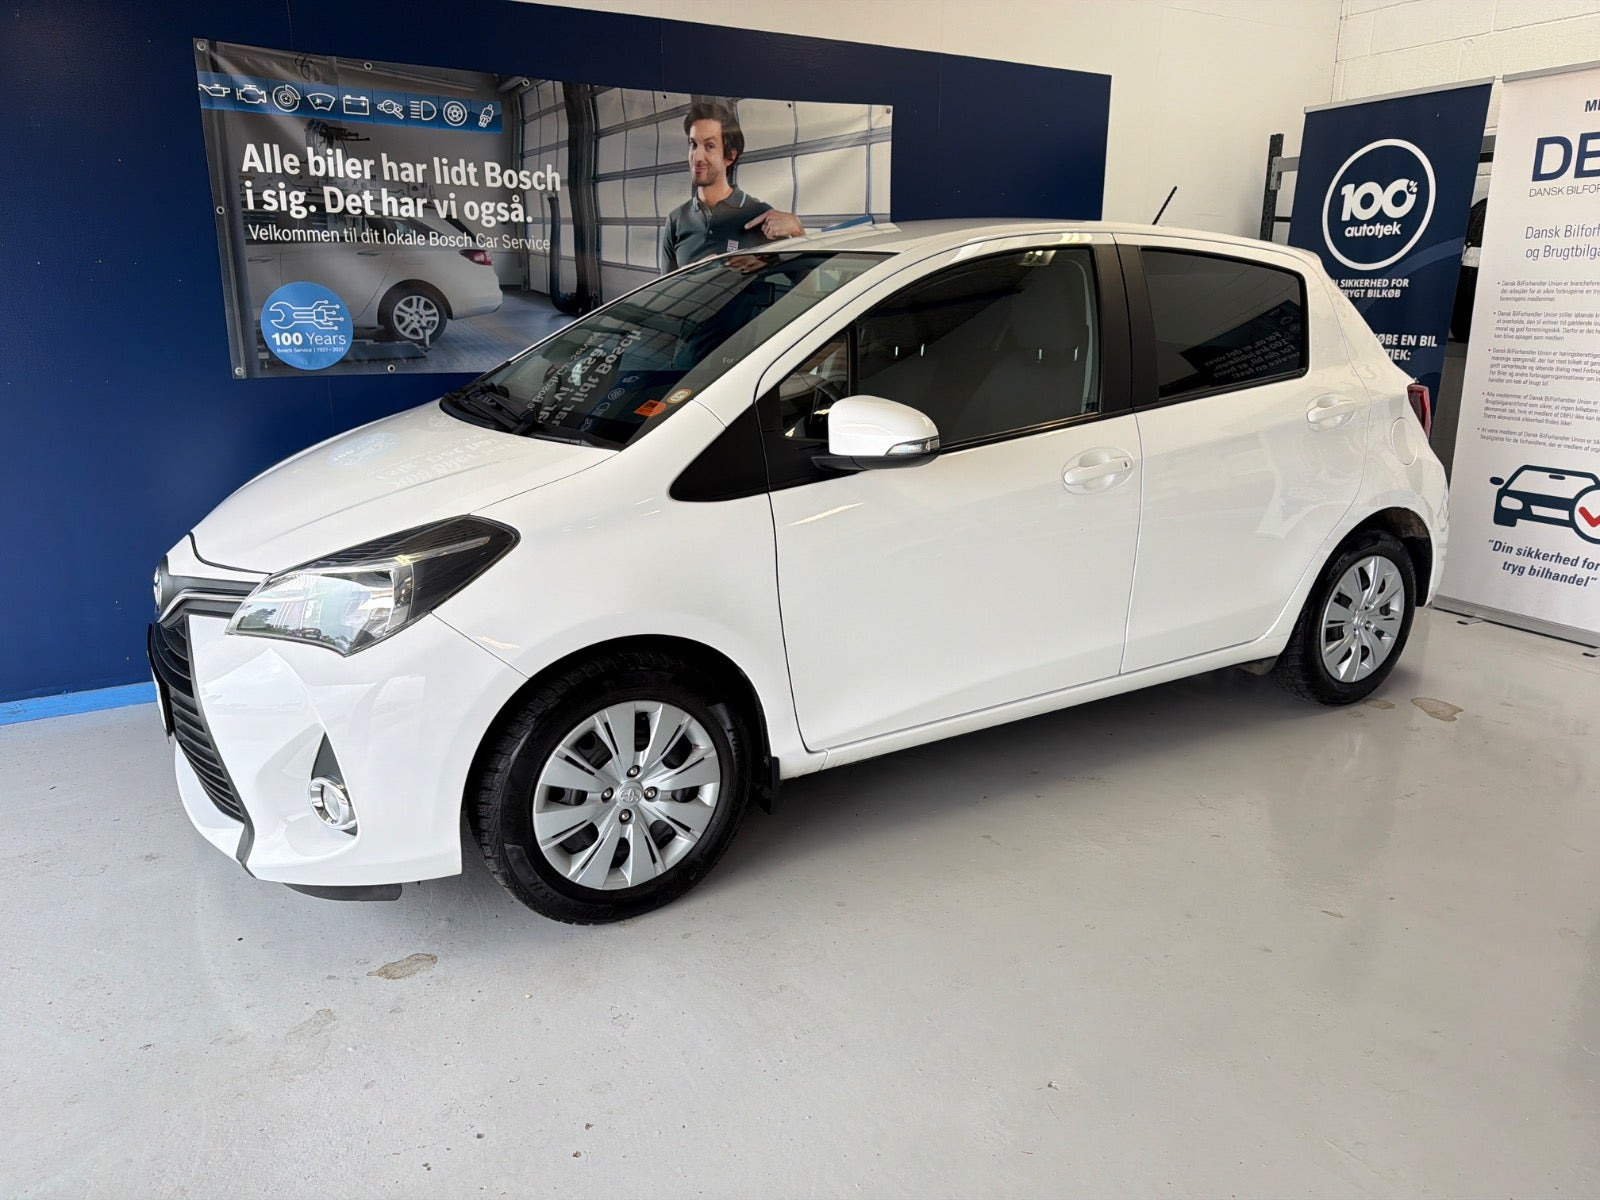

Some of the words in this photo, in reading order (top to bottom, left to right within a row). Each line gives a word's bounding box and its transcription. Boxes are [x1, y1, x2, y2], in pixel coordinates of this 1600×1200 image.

[1585, 99, 1600, 112] M
[242, 143, 300, 174] Alle
[306, 146, 374, 180] biler
[381, 153, 427, 183] har
[433, 157, 479, 186] lidt
[484, 162, 561, 192] Bosch
[1529, 186, 1565, 198] DANSK
[245, 180, 255, 210] i
[262, 182, 317, 219] sig.
[322, 186, 376, 216] Det
[381, 188, 427, 218] har
[433, 192, 458, 219] vi
[464, 194, 532, 228] også.
[248, 224, 340, 242] Velkommen
[344, 228, 357, 243] til
[360, 228, 380, 244] dit
[384, 228, 425, 246] lokale
[430, 232, 472, 248] Bosch
[476, 233, 498, 248] Car
[502, 234, 550, 250] Service
[1344, 222, 1402, 238] autotjek
[1526, 225, 1560, 239] Dansk
[1526, 248, 1540, 261] og
[1340, 278, 1389, 288] SIKKERHED
[1391, 278, 1410, 288] FOR
[1367, 289, 1401, 298] BILKØB
[272, 332, 302, 346] 100
[306, 332, 346, 345] Years
[1374, 333, 1398, 345] ØBE
[1401, 334, 1417, 346] EN
[1420, 336, 1438, 347] BIL
[1516, 546, 1580, 567] sikkerhed
[1581, 558, 1600, 571] for
[1502, 560, 1526, 576] tryg
